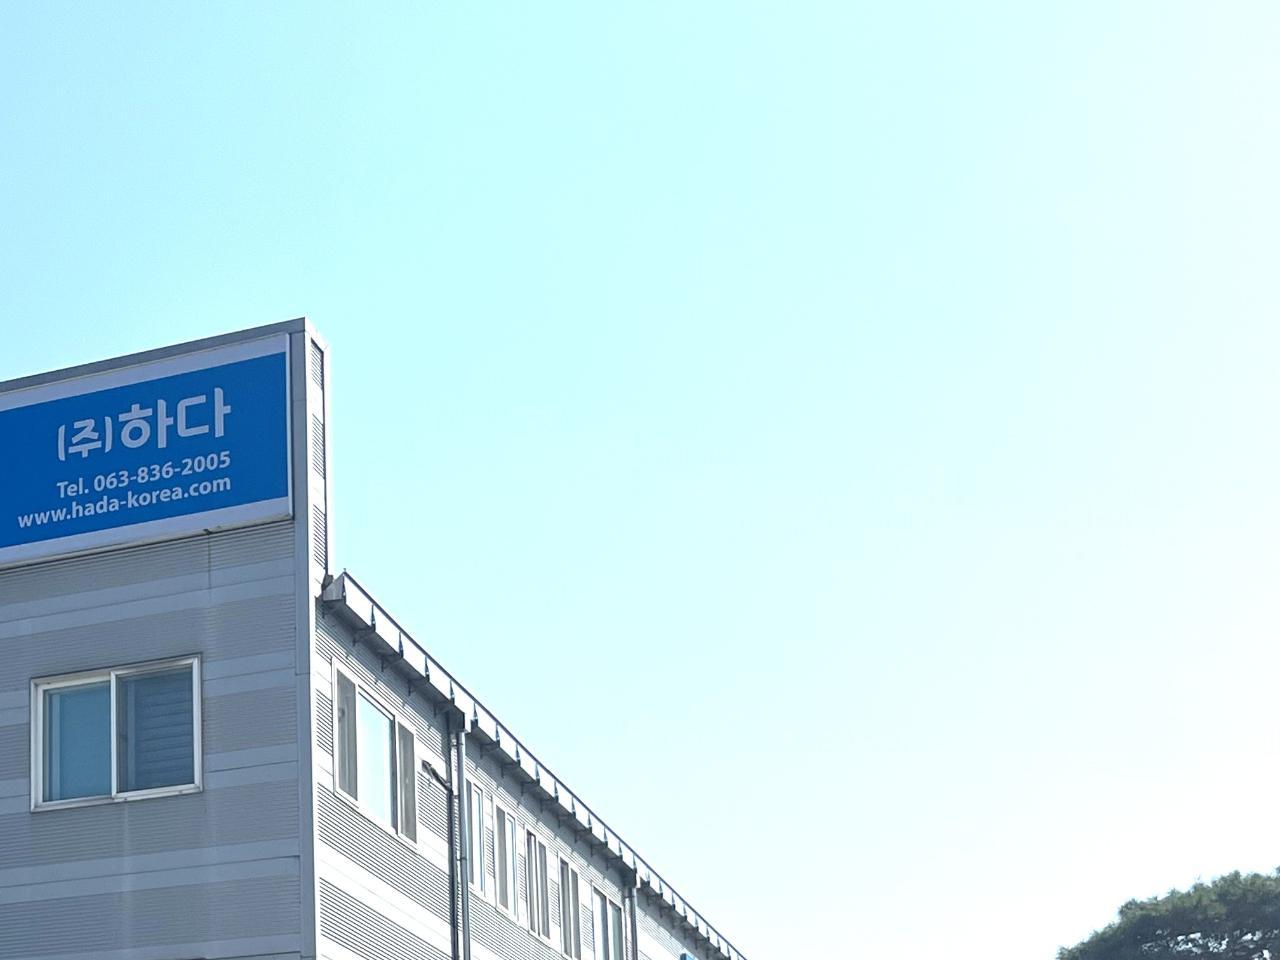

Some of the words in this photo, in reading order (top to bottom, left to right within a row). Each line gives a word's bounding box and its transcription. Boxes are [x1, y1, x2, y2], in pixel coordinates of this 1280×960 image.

[57, 477, 89, 498] Tel.
[94, 451, 231, 492] 063-836-2005
[18, 477, 231, 528] www.hada-korea.com
